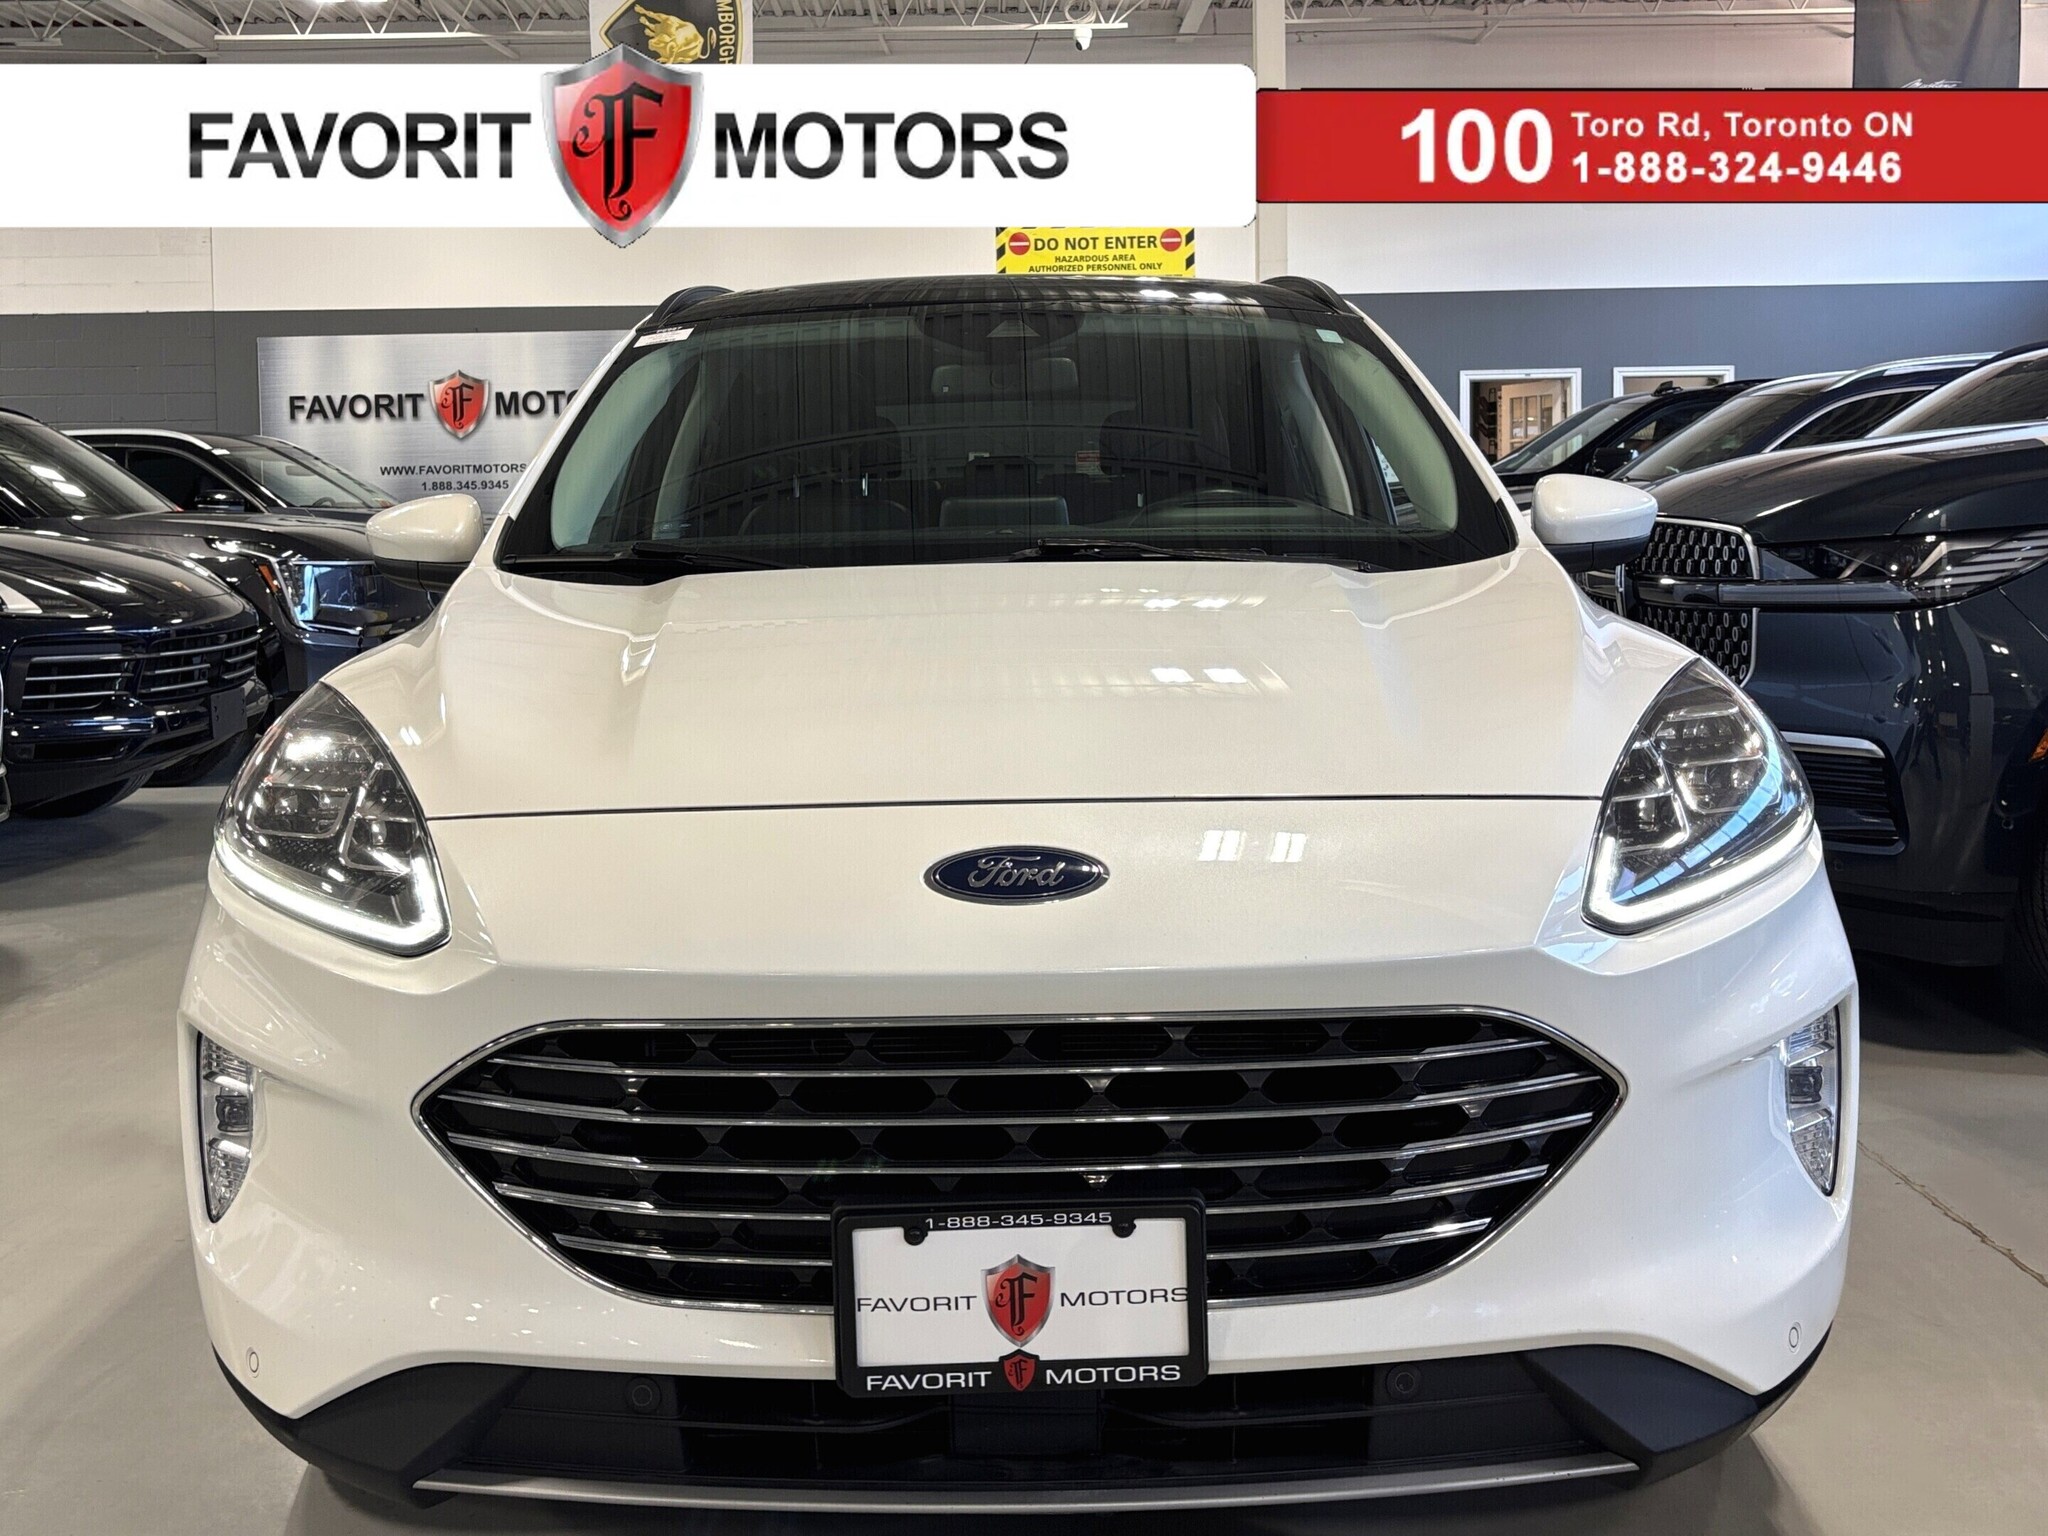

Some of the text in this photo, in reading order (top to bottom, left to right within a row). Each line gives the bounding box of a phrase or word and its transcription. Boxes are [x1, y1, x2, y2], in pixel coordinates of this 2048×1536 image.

[1034, 235, 1158, 251] DO NOT ENTER
[1028, 262, 1163, 273] AUTHORIZED PERSONNEL ONLY
[1055, 254, 1136, 263] HAZARDOUS AREA
[289, 393, 424, 420] FAVORIT
[421, 480, 510, 491] 1.888.345.9345
[967, 855, 1066, 888] Ford
[925, 1212, 1112, 1230] 1-888-345-9345
[857, 1295, 977, 1312] FAVORIT
[1060, 1287, 1188, 1307] MOTORS
[866, 1371, 992, 1391] FAVORIT
[1046, 1364, 1181, 1385] MOTORS
